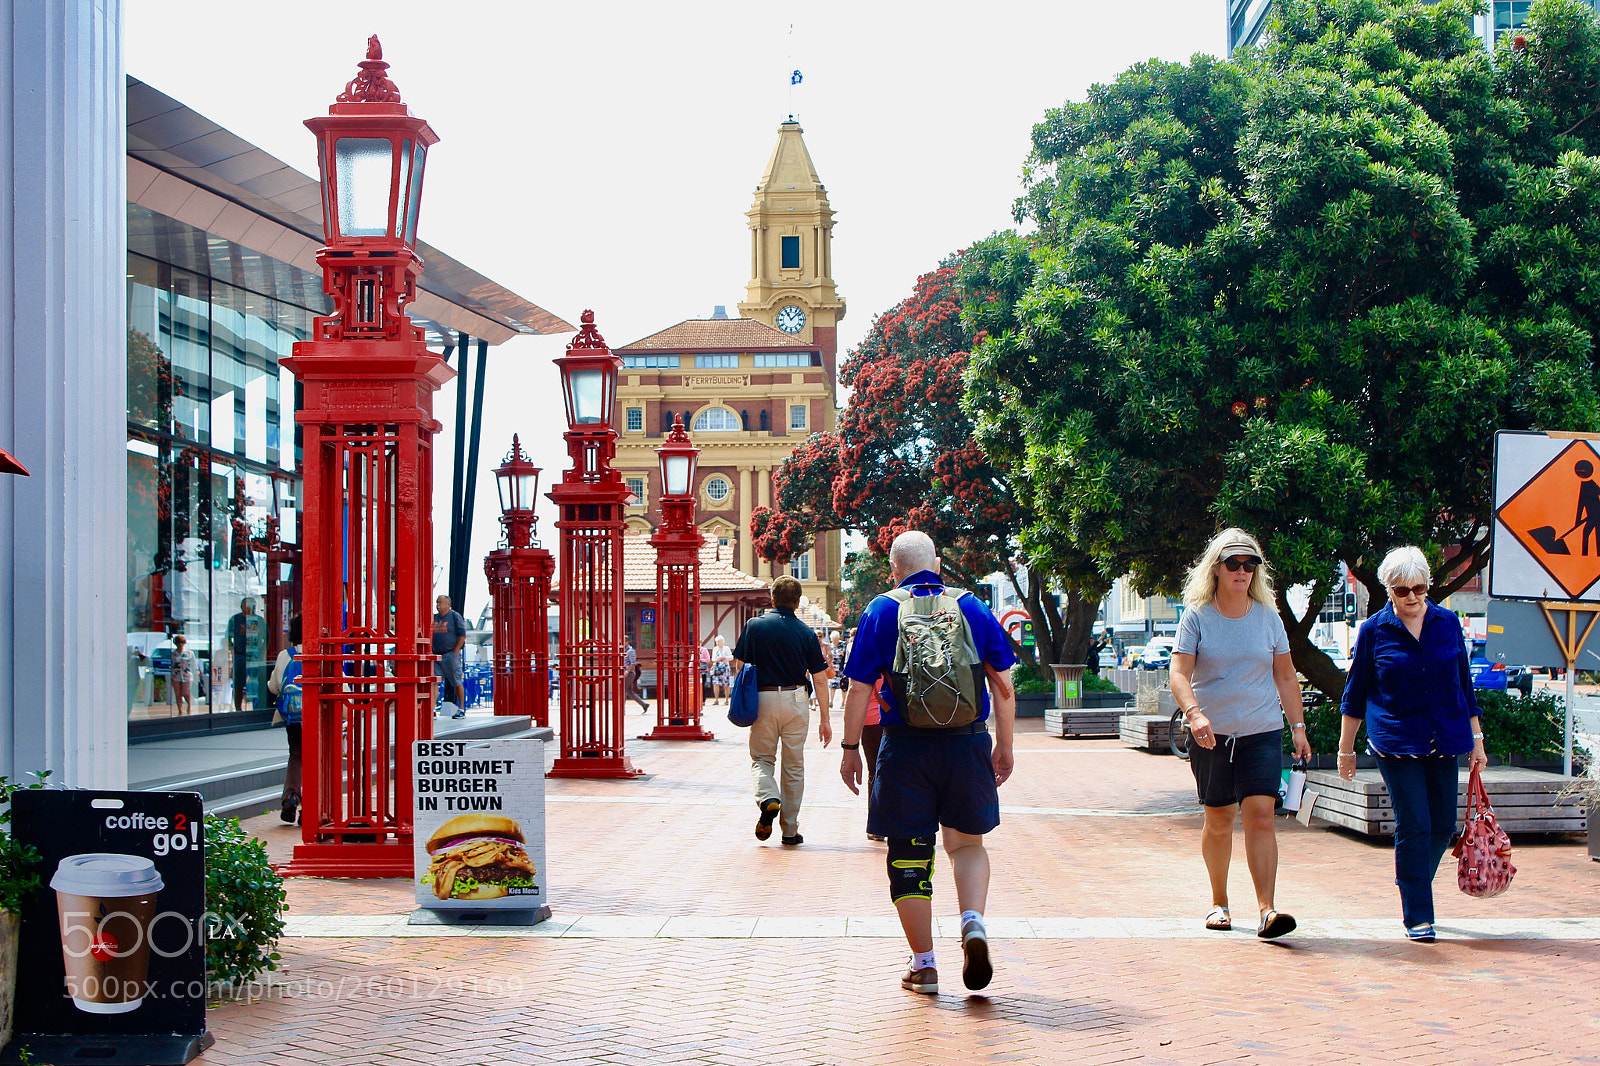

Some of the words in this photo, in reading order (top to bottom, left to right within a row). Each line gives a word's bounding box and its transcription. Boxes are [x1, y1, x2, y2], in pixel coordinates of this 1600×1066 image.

[417, 743, 466, 757] BEST
[417, 760, 515, 775] GOURMET
[418, 778, 498, 793] BURGER
[418, 796, 438, 811] IN
[445, 796, 503, 811] TOWN
[105, 812, 169, 830] coffee
[174, 813, 187, 830] 2
[152, 821, 199, 856] go!
[508, 887, 522, 895] Kids
[522, 887, 539, 895] Menu
